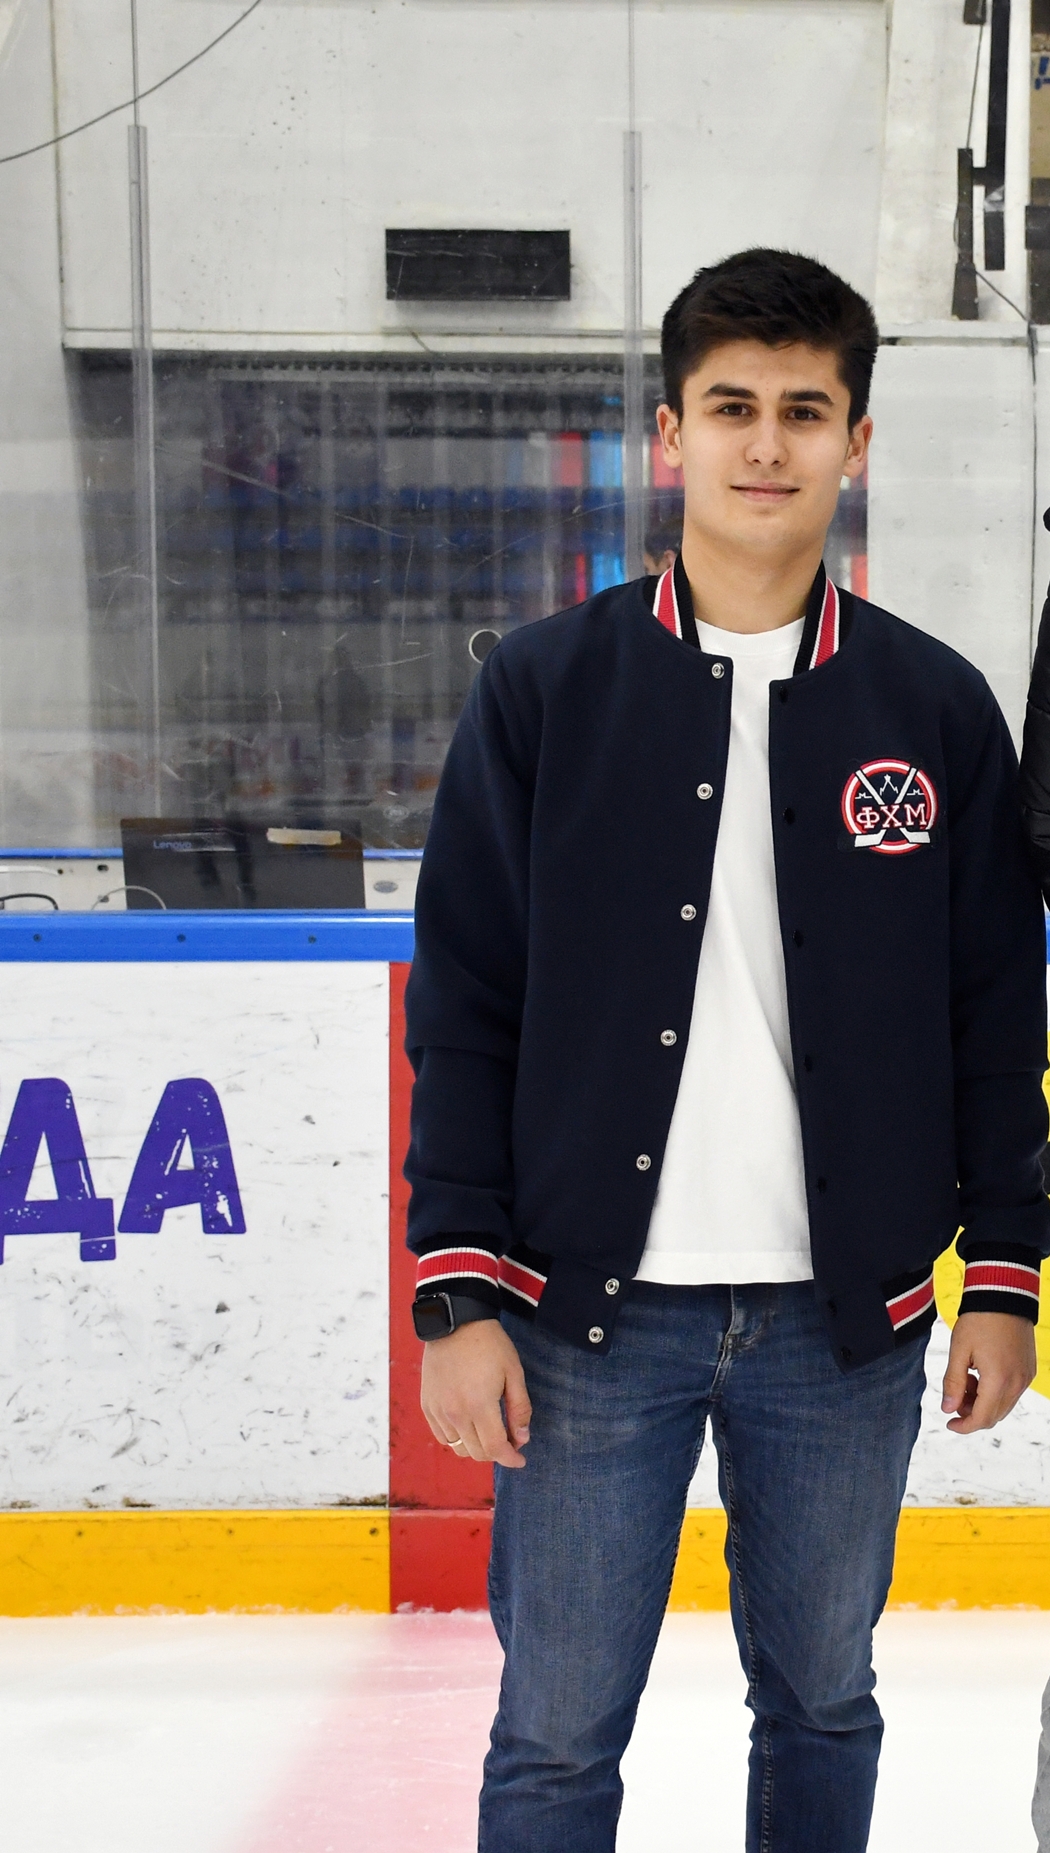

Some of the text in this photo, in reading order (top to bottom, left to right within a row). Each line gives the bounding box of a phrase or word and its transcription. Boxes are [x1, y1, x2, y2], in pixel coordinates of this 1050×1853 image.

[856, 803, 928, 829] ФХМ
[153, 840, 193, 851] Lenovo
[0, 1077, 247, 1265] ДА
